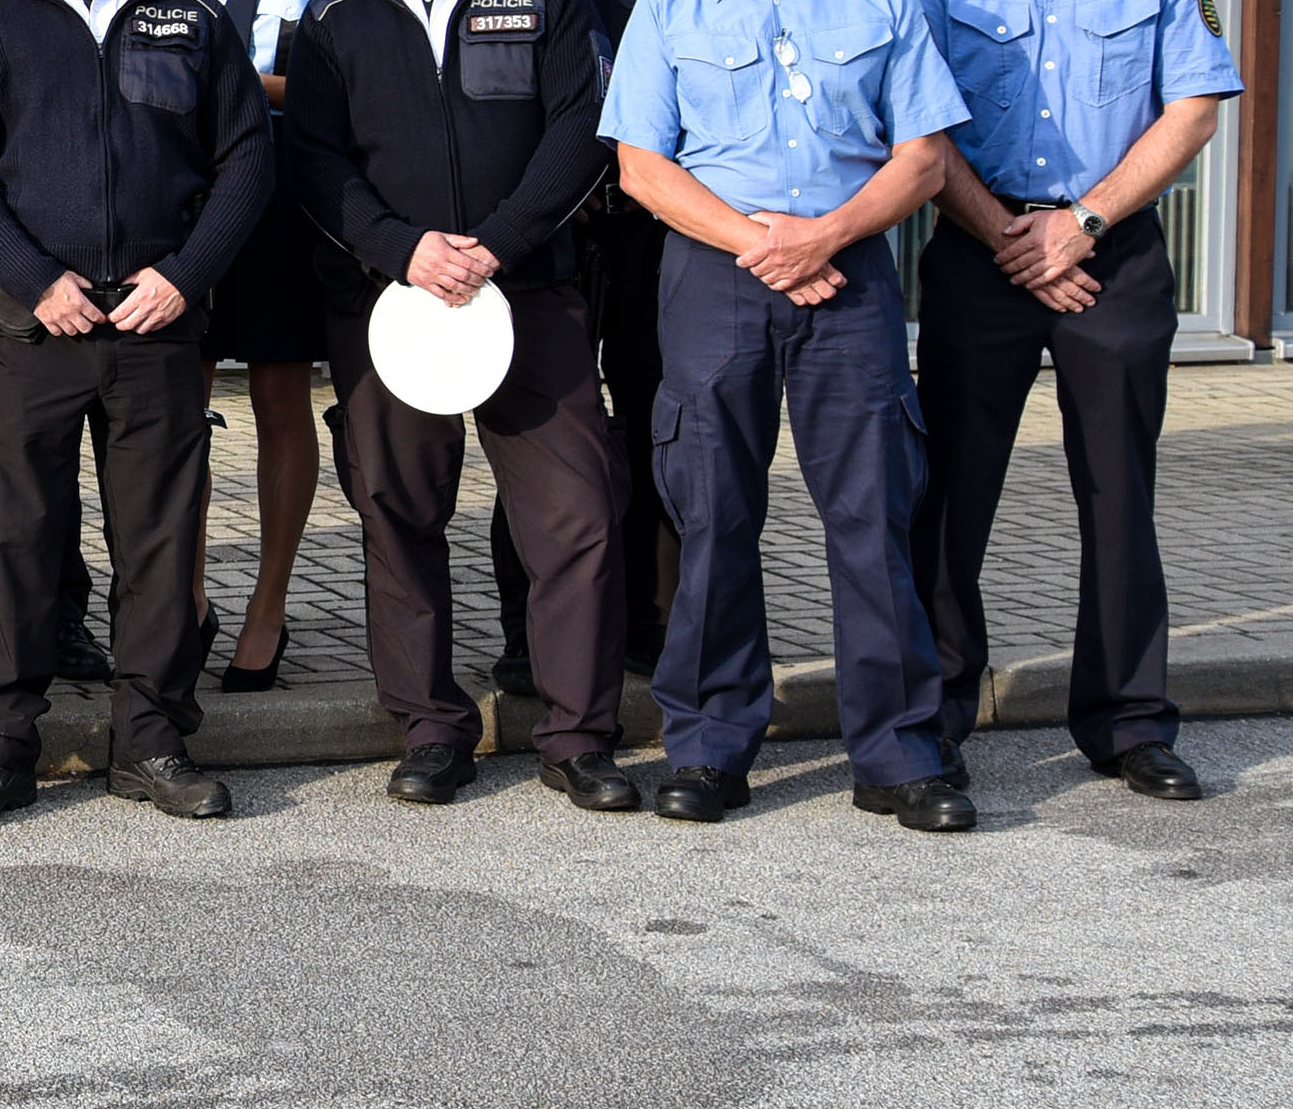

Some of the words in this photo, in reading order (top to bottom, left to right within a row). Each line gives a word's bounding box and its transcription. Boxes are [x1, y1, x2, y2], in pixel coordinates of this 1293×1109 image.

[135, 5, 198, 22] POLICIE
[137, 20, 189, 37] 314668
[476, 14, 531, 31] 317353
